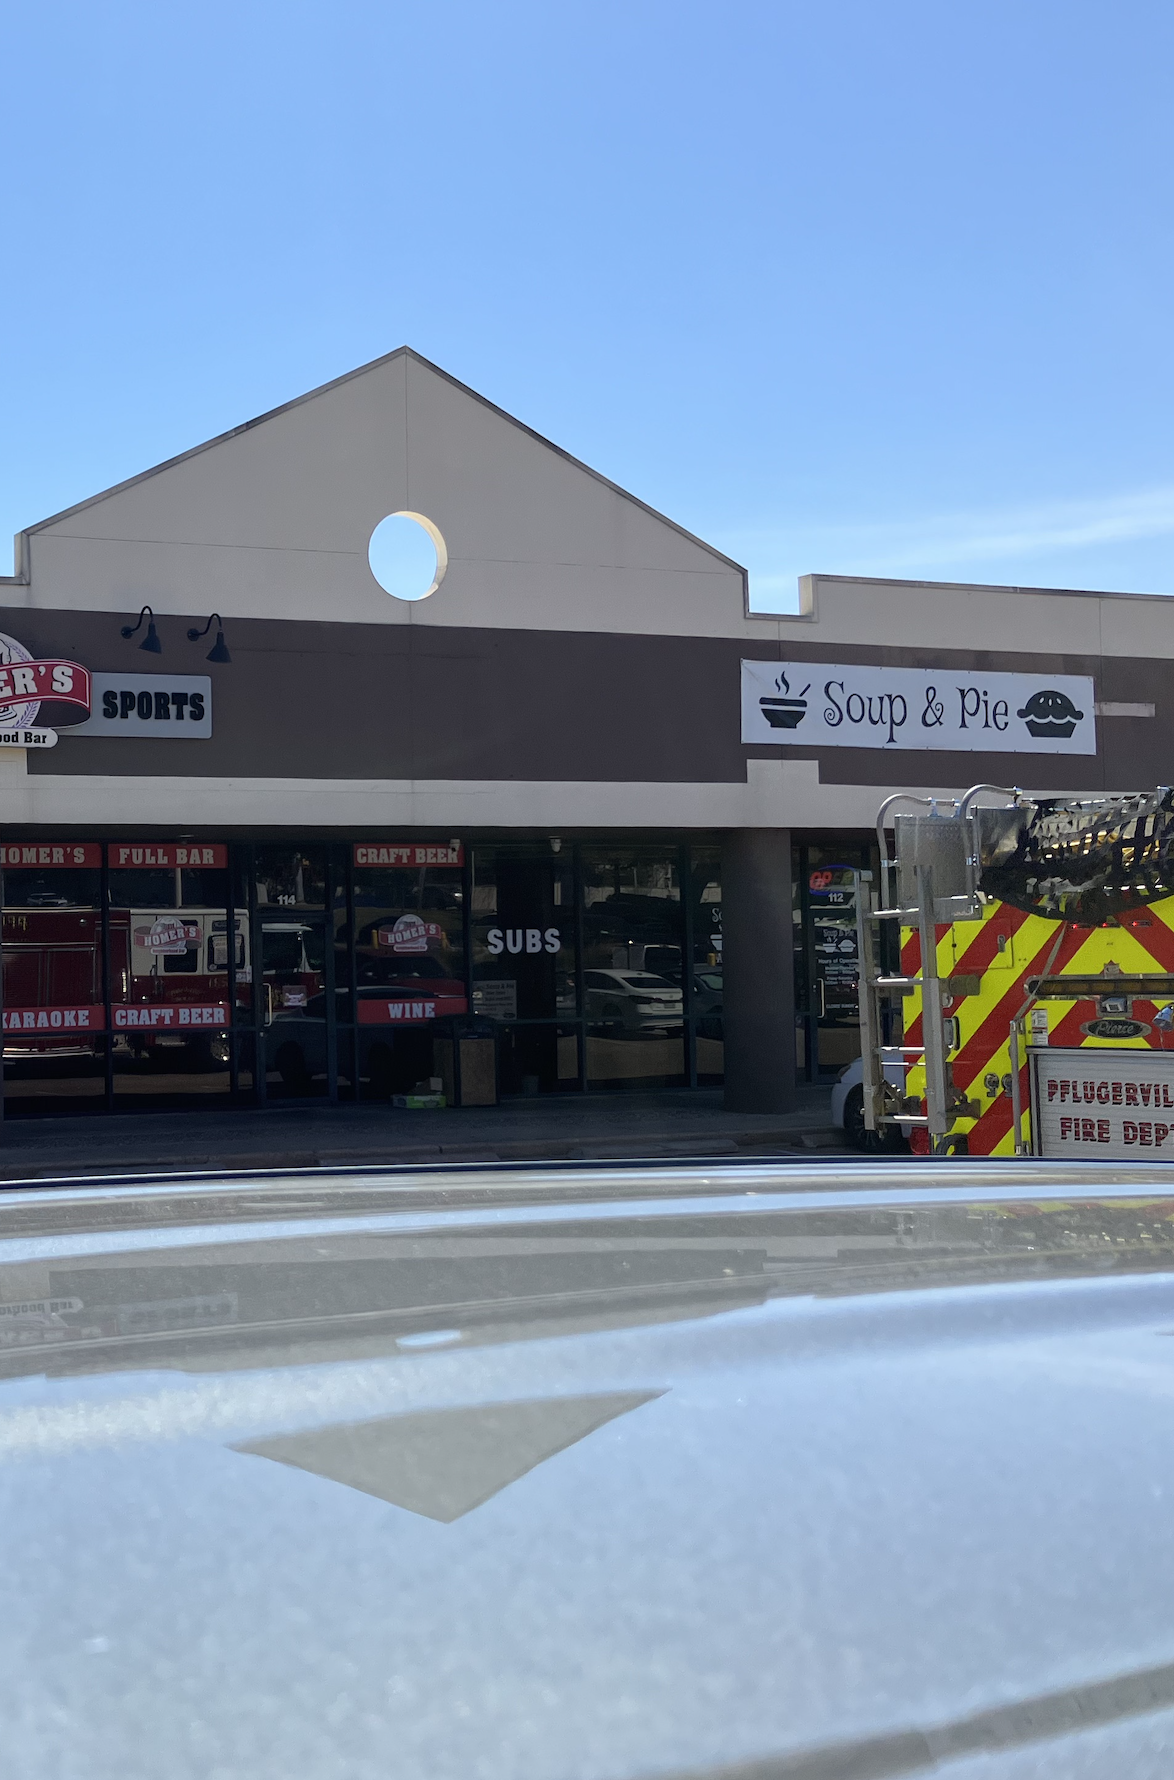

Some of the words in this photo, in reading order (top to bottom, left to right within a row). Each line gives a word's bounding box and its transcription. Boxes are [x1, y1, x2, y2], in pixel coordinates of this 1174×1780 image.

[103, 690, 204, 721] SPORTS
[823, 680, 907, 744] Soup
[921, 686, 944, 728] &
[956, 687, 1009, 731] Pie
[24, 732, 47, 744] Bar
[119, 848, 168, 864] FULL
[176, 848, 214, 864] BAR
[356, 848, 411, 864] CRAFT
[416, 848, 458, 864] BEER
[277, 895, 296, 905] 114
[828, 893, 844, 902] 112
[143, 927, 196, 946] HOMER'S
[388, 924, 436, 944] HOMER'S
[487, 928, 561, 954] SUBS
[115, 1008, 173, 1026] CRAFT
[179, 1007, 225, 1025] BEER
[388, 1002, 435, 1019] WINE
[1095, 1021, 1134, 1036] Pierce
[1047, 1079, 1174, 1108] PFLUGERVIL
[1059, 1117, 1111, 1143] FIRE
